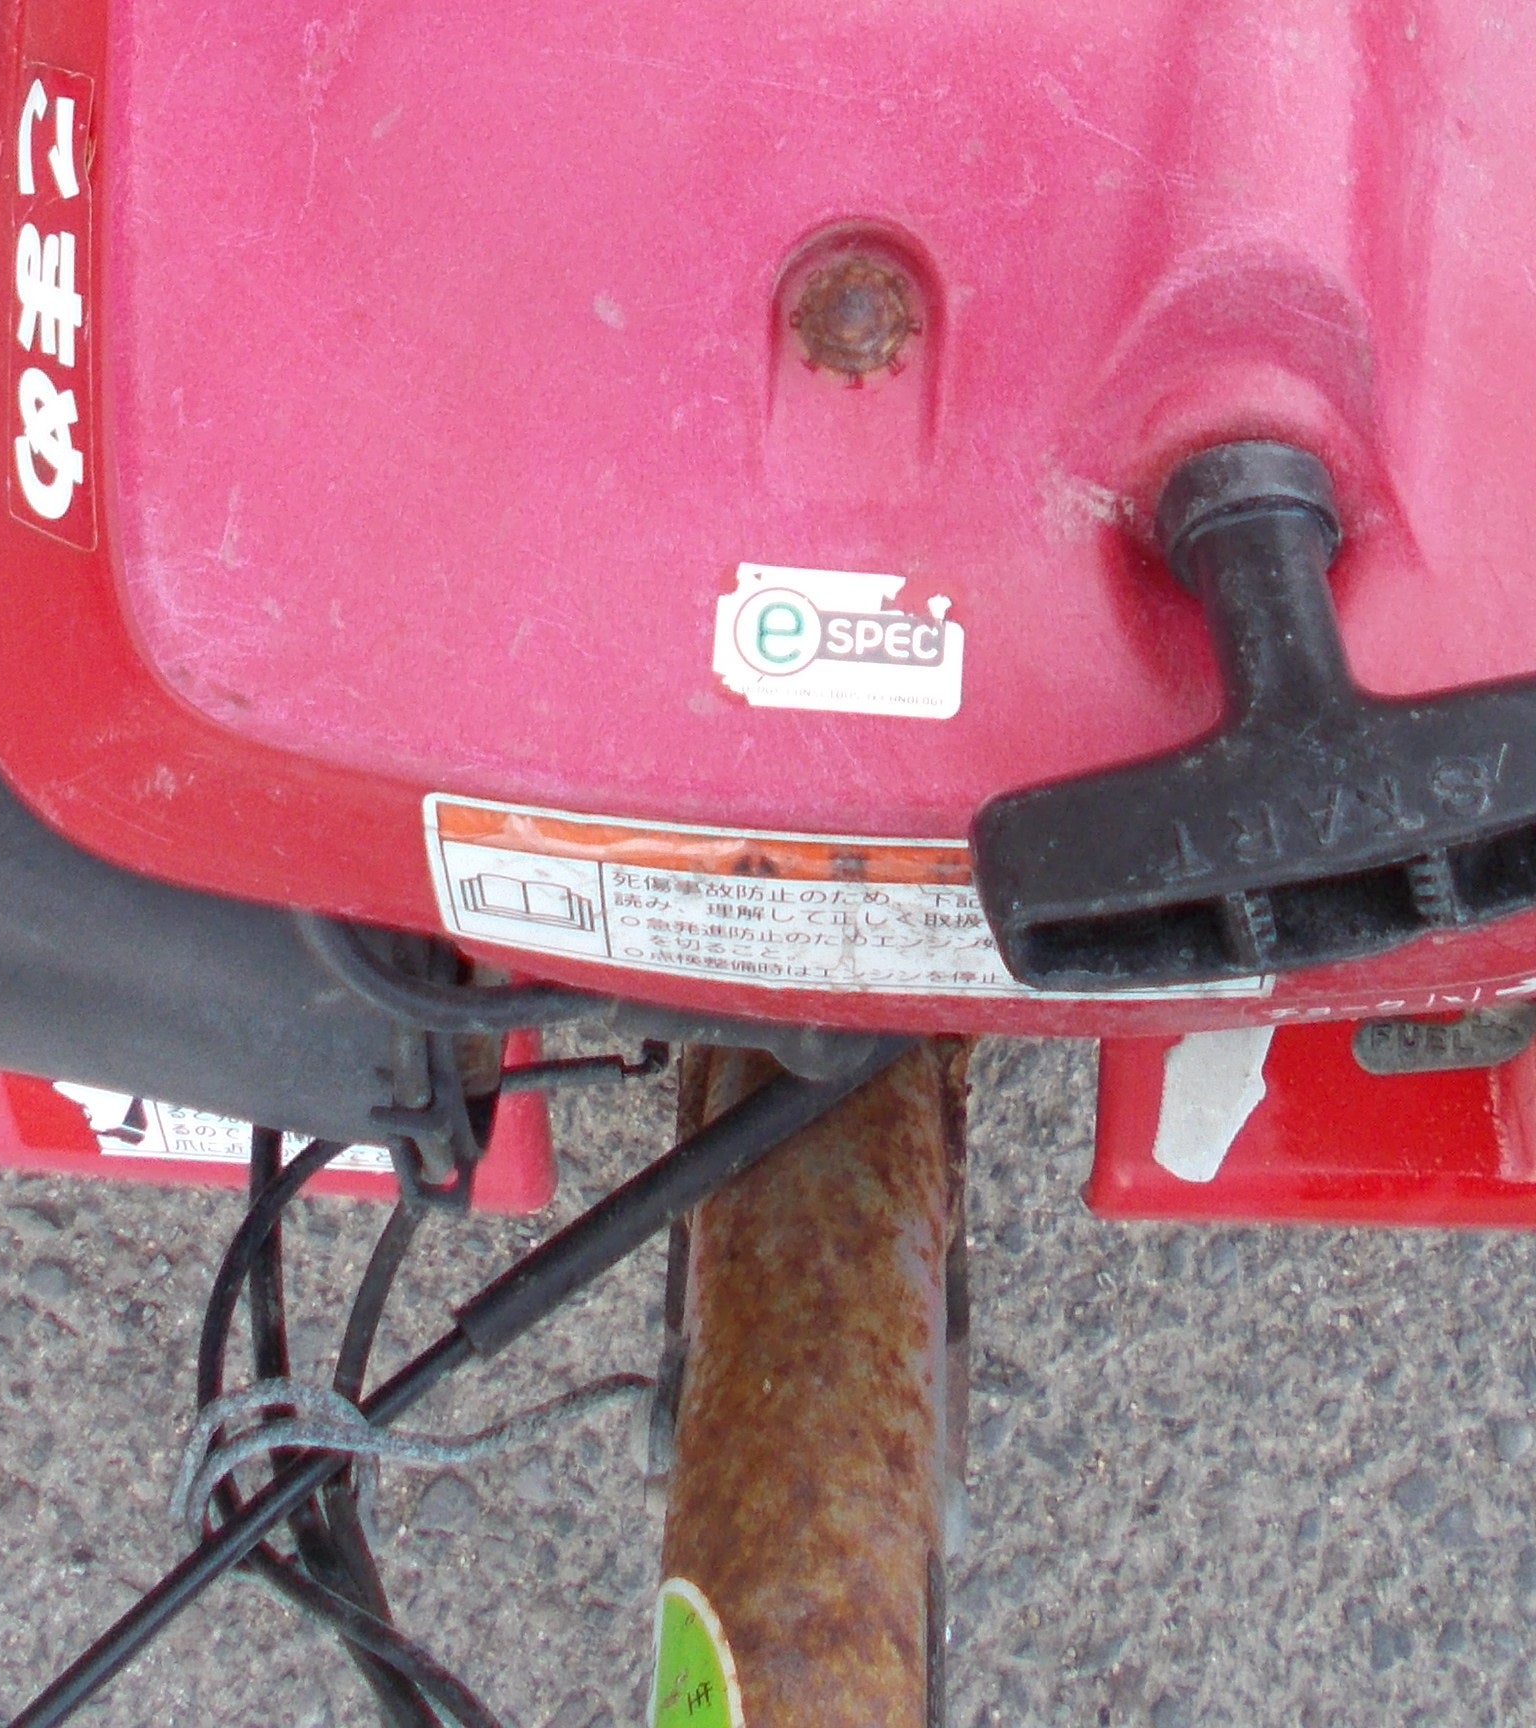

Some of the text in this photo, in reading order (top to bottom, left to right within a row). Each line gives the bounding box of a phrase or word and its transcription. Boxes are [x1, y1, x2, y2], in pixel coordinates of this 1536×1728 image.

[15, 78, 83, 520] こまめ
[826, 618, 939, 660] SPEC
[1150, 756, 1492, 881] START
